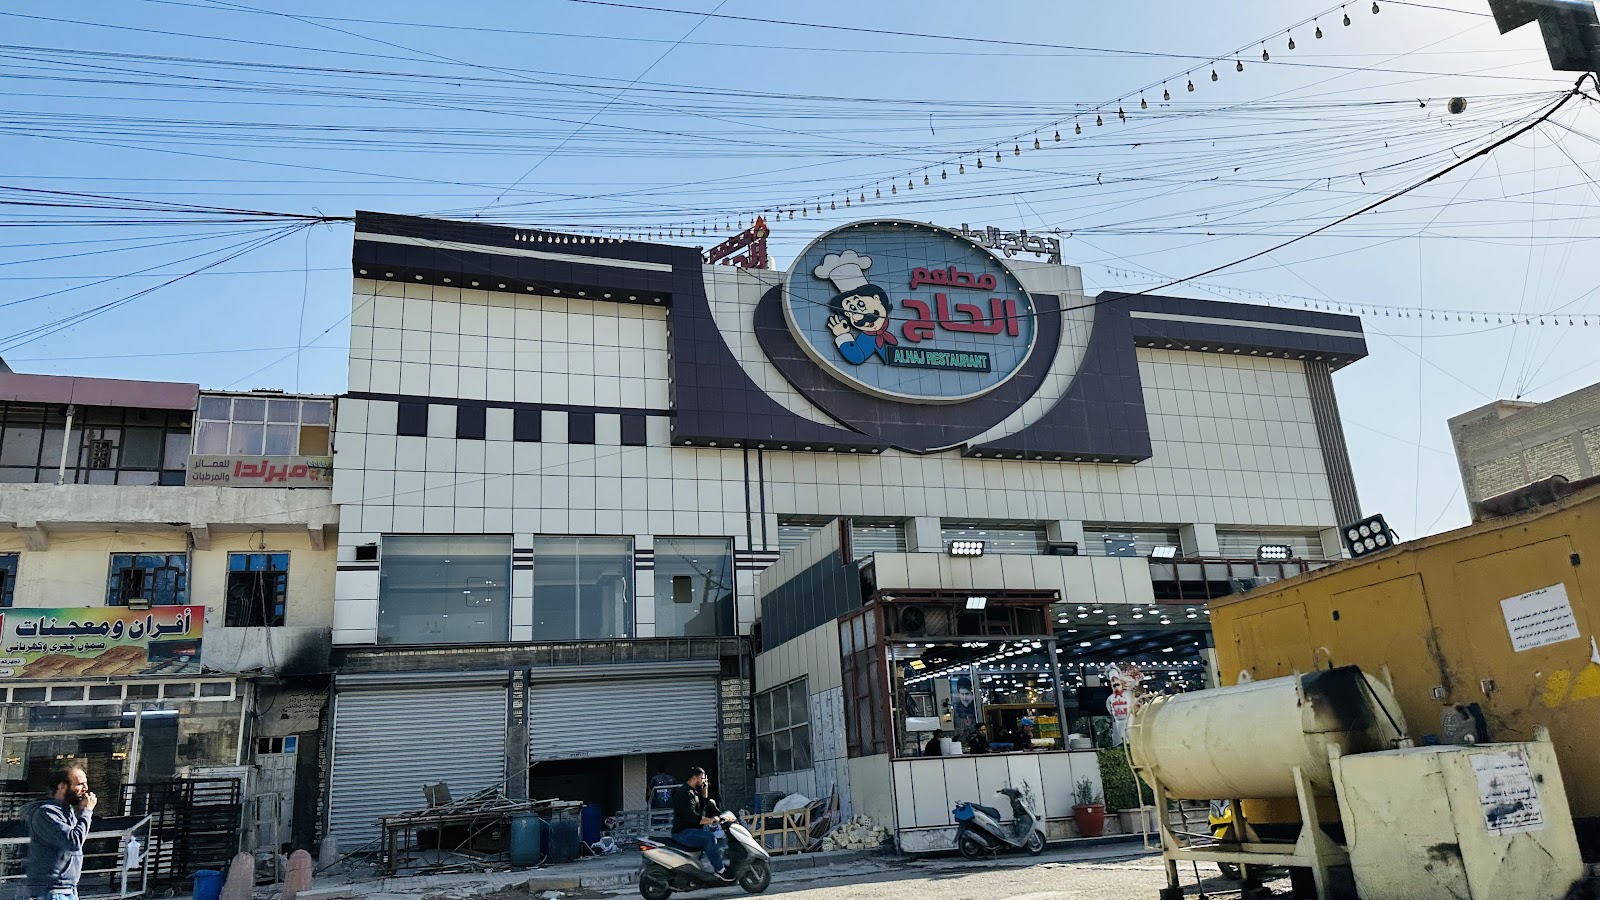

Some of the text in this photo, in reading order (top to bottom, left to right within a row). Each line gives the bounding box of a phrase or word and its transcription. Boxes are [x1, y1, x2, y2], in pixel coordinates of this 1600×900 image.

[947, 222, 1060, 259] دجاج الحا
[911, 265, 998, 291] مطعم
[902, 293, 1019, 343] الحاج
[894, 349, 988, 369] ALHAJ RESTAURANT
[194, 459, 231, 470] للعصائر
[233, 460, 309, 483] ميرندا
[192, 472, 230, 483] والمرطبات
[15, 608, 193, 640] أفران ومعجنات
